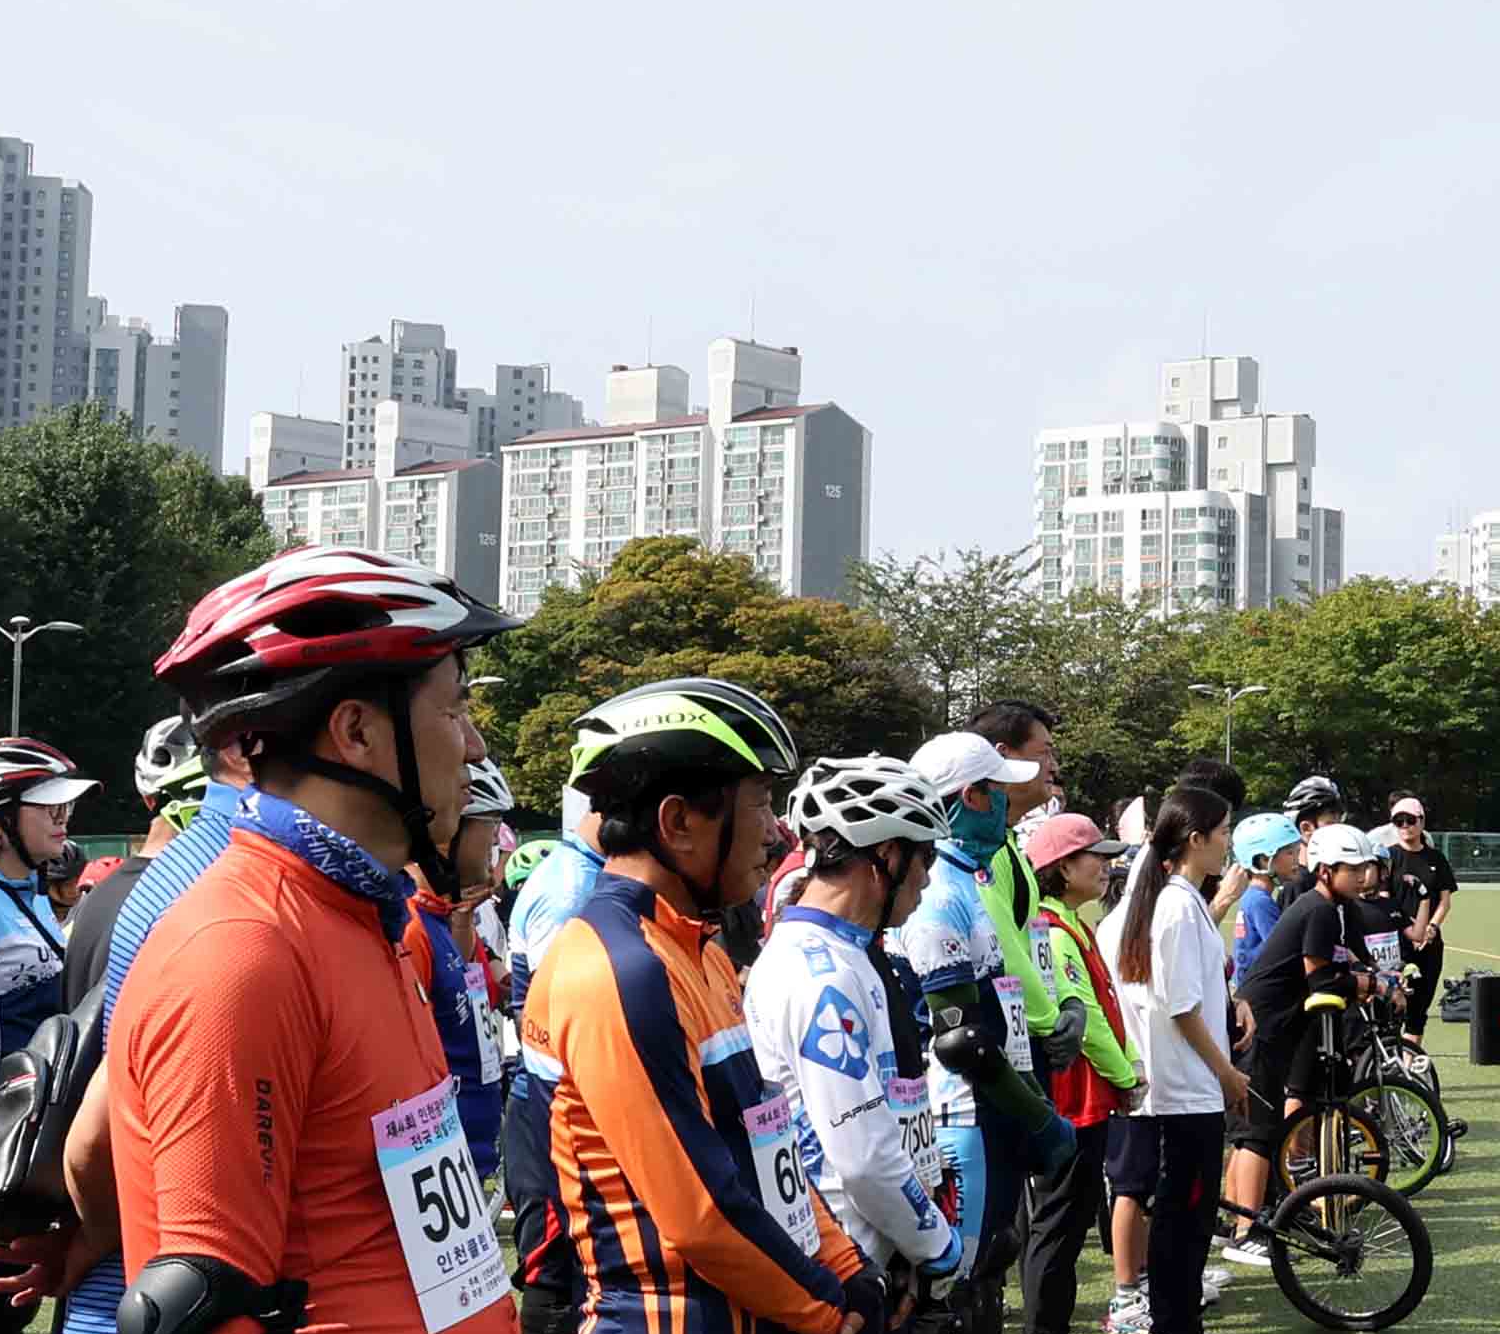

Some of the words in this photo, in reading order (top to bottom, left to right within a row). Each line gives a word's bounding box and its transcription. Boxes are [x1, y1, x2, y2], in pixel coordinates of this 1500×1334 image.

[386, 1113, 417, 1139] 제4회
[412, 1148, 484, 1244] 501
[940, 1143, 964, 1228] UNICYCLE
